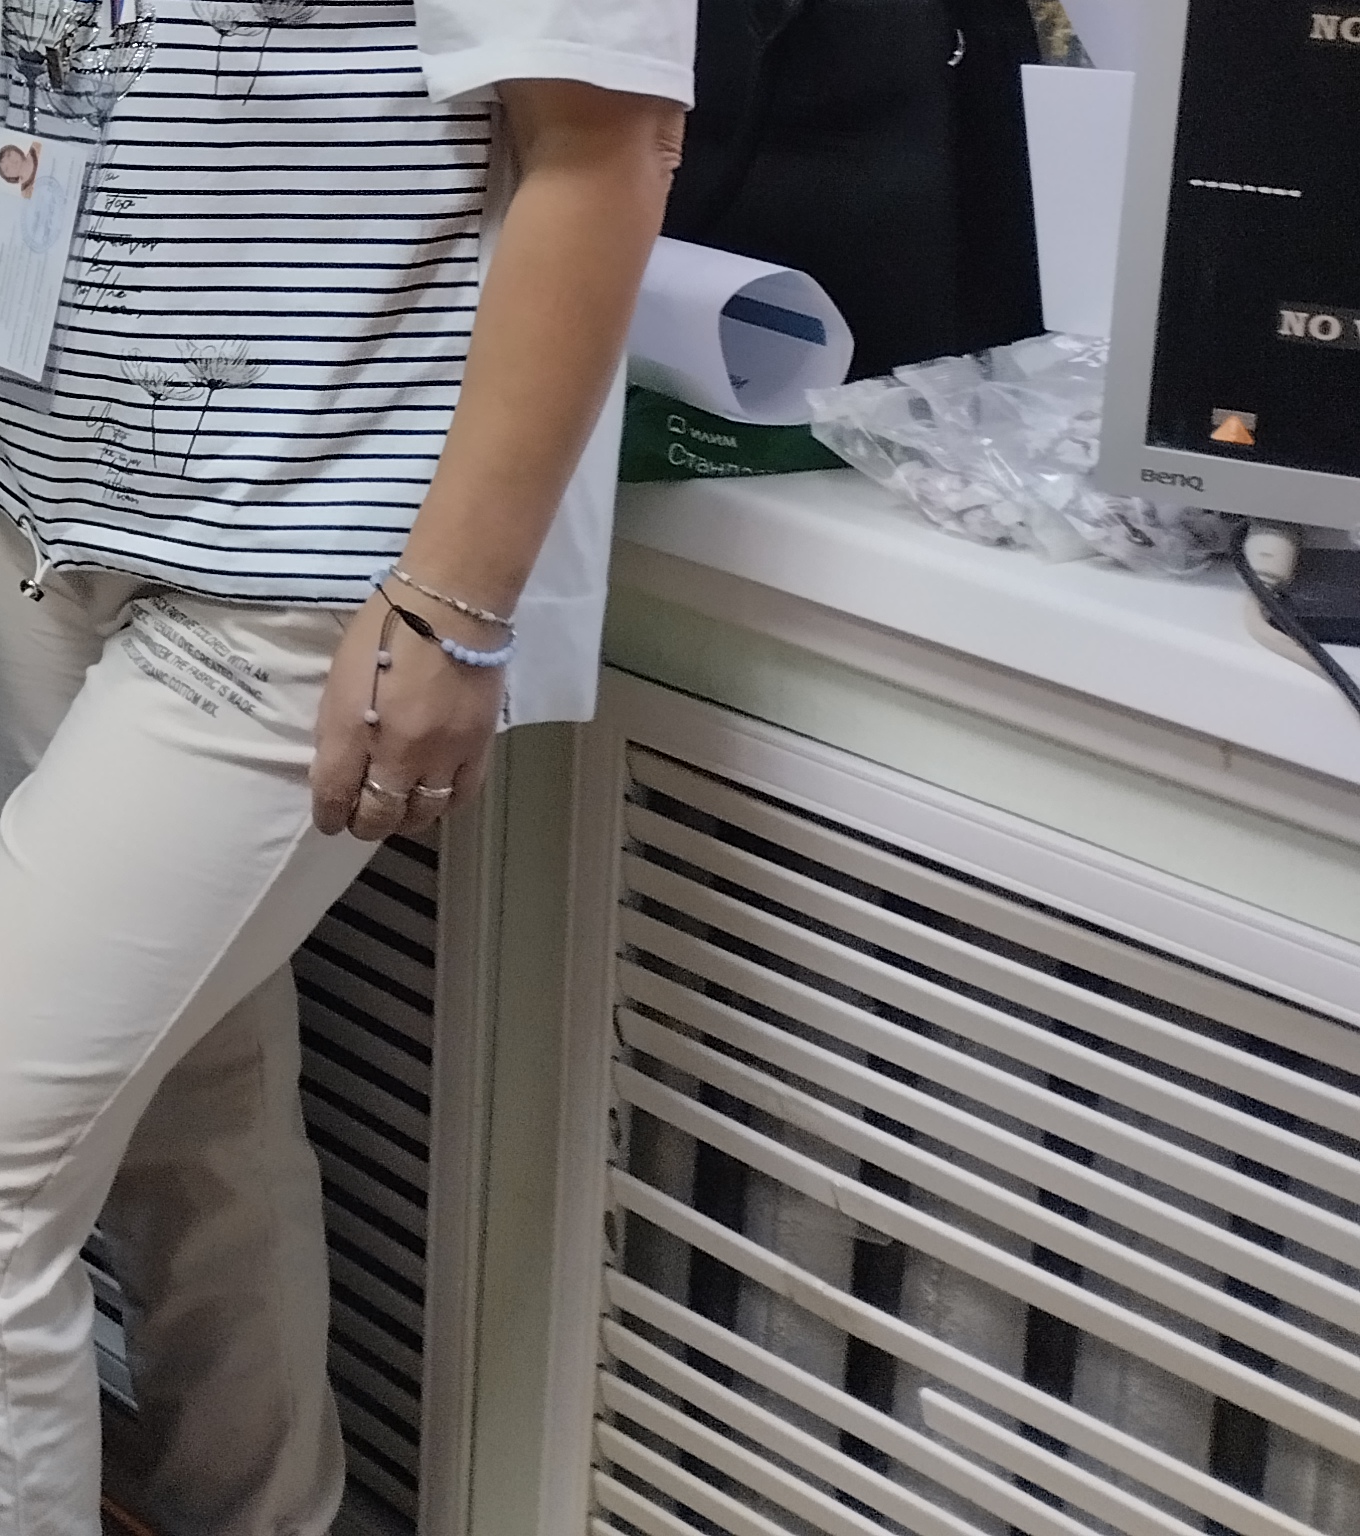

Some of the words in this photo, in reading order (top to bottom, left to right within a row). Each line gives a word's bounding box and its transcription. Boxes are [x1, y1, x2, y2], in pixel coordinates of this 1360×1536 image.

[1277, 310, 1342, 341] NO
[227, 652, 253, 674] WITH
[217, 684, 228, 696] IS
